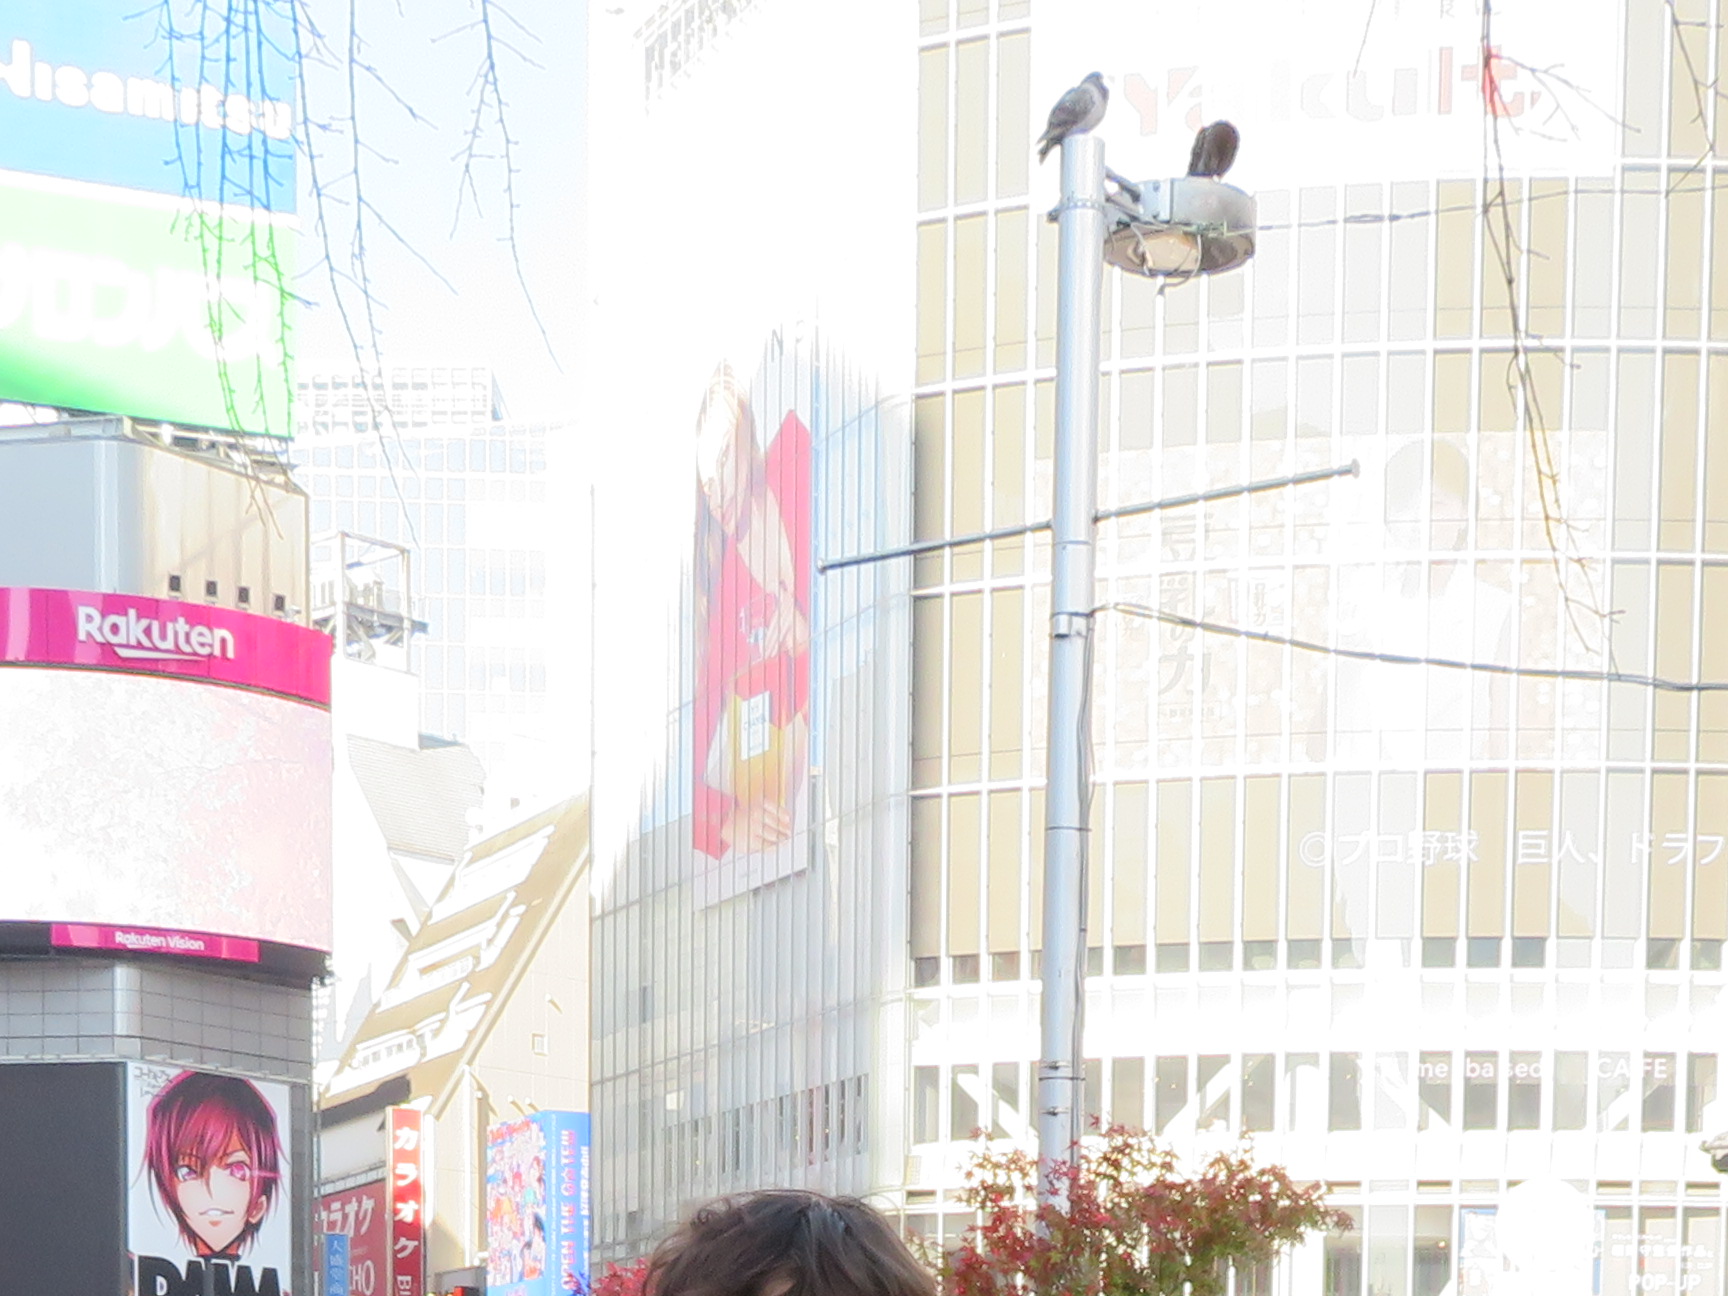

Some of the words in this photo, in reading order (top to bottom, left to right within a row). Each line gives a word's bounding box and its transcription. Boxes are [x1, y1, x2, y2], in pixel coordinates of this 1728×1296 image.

[77, 604, 234, 660] Rakuten
[115, 930, 166, 948] Rakuten
[168, 934, 204, 952] Vision
[393, 1126, 421, 1259] カラオケ
